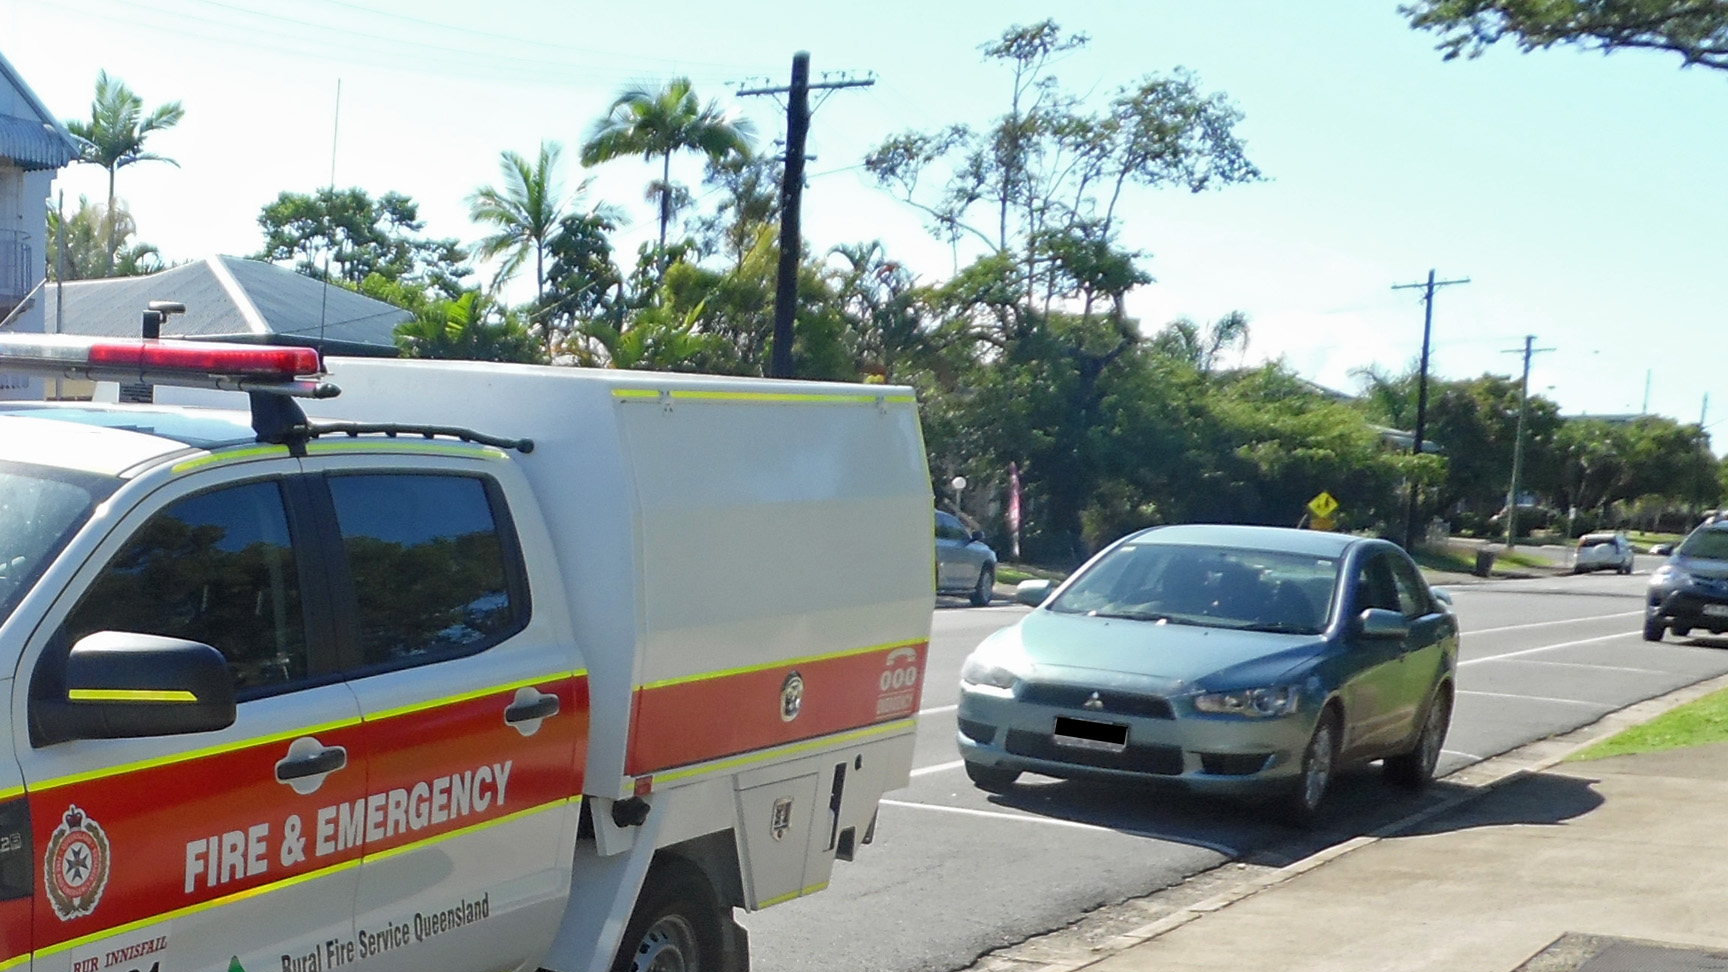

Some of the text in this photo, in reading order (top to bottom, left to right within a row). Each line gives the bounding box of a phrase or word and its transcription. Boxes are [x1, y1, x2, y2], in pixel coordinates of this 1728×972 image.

[880, 666, 917, 691] 000
[184, 823, 270, 894] FIRE
[279, 814, 306, 867] &
[315, 760, 513, 857] EMERGENCY
[104, 935, 168, 968] INNISFAIL
[325, 938, 355, 970] Fire
[358, 920, 410, 959] Service
[413, 892, 490, 943] Queensland
